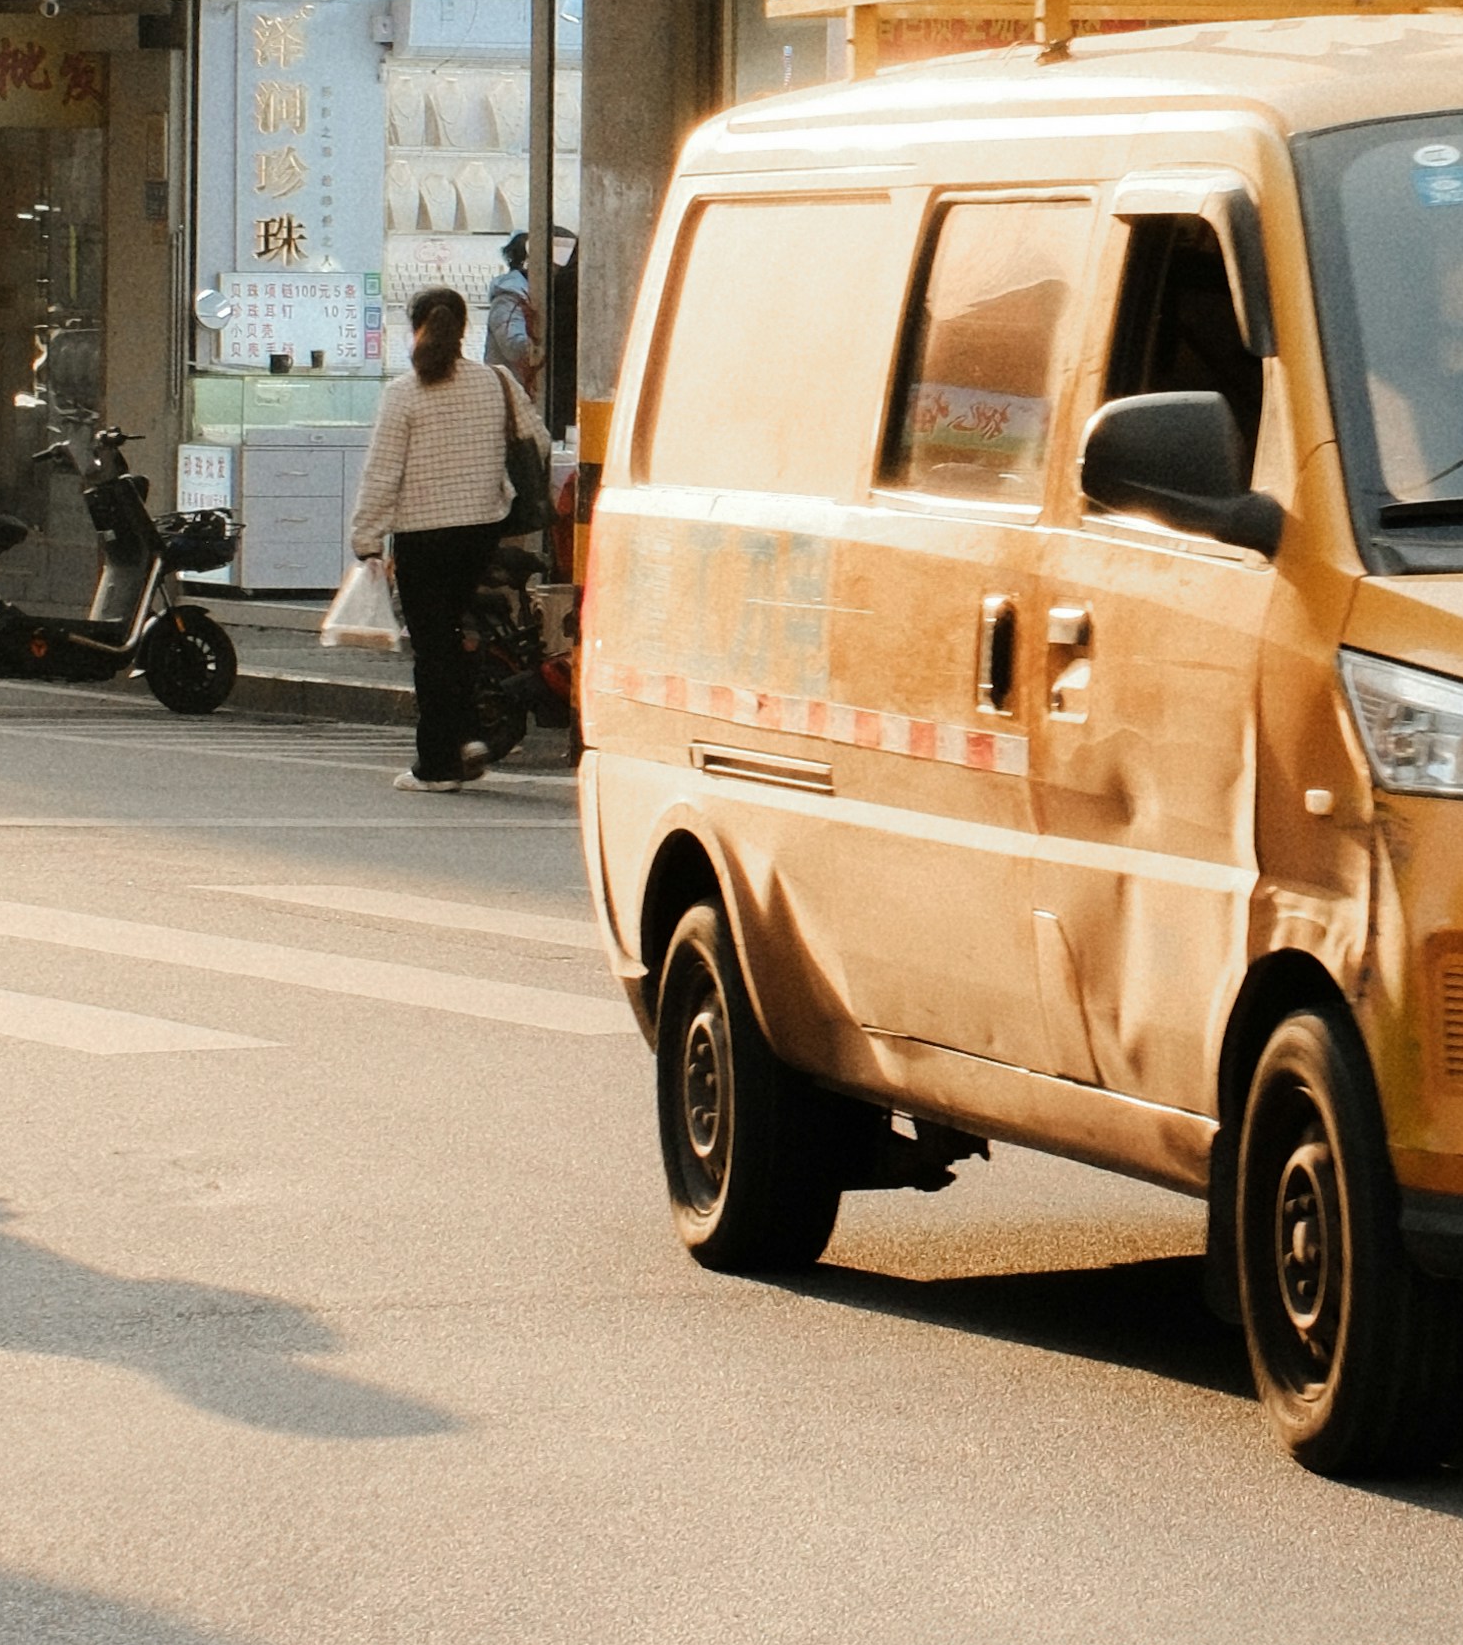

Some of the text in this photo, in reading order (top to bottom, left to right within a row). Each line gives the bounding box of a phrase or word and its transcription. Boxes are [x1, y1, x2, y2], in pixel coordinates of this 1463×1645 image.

[254, 14, 309, 267] 泽润珍珠
[230, 324, 274, 339] 小贝壳
